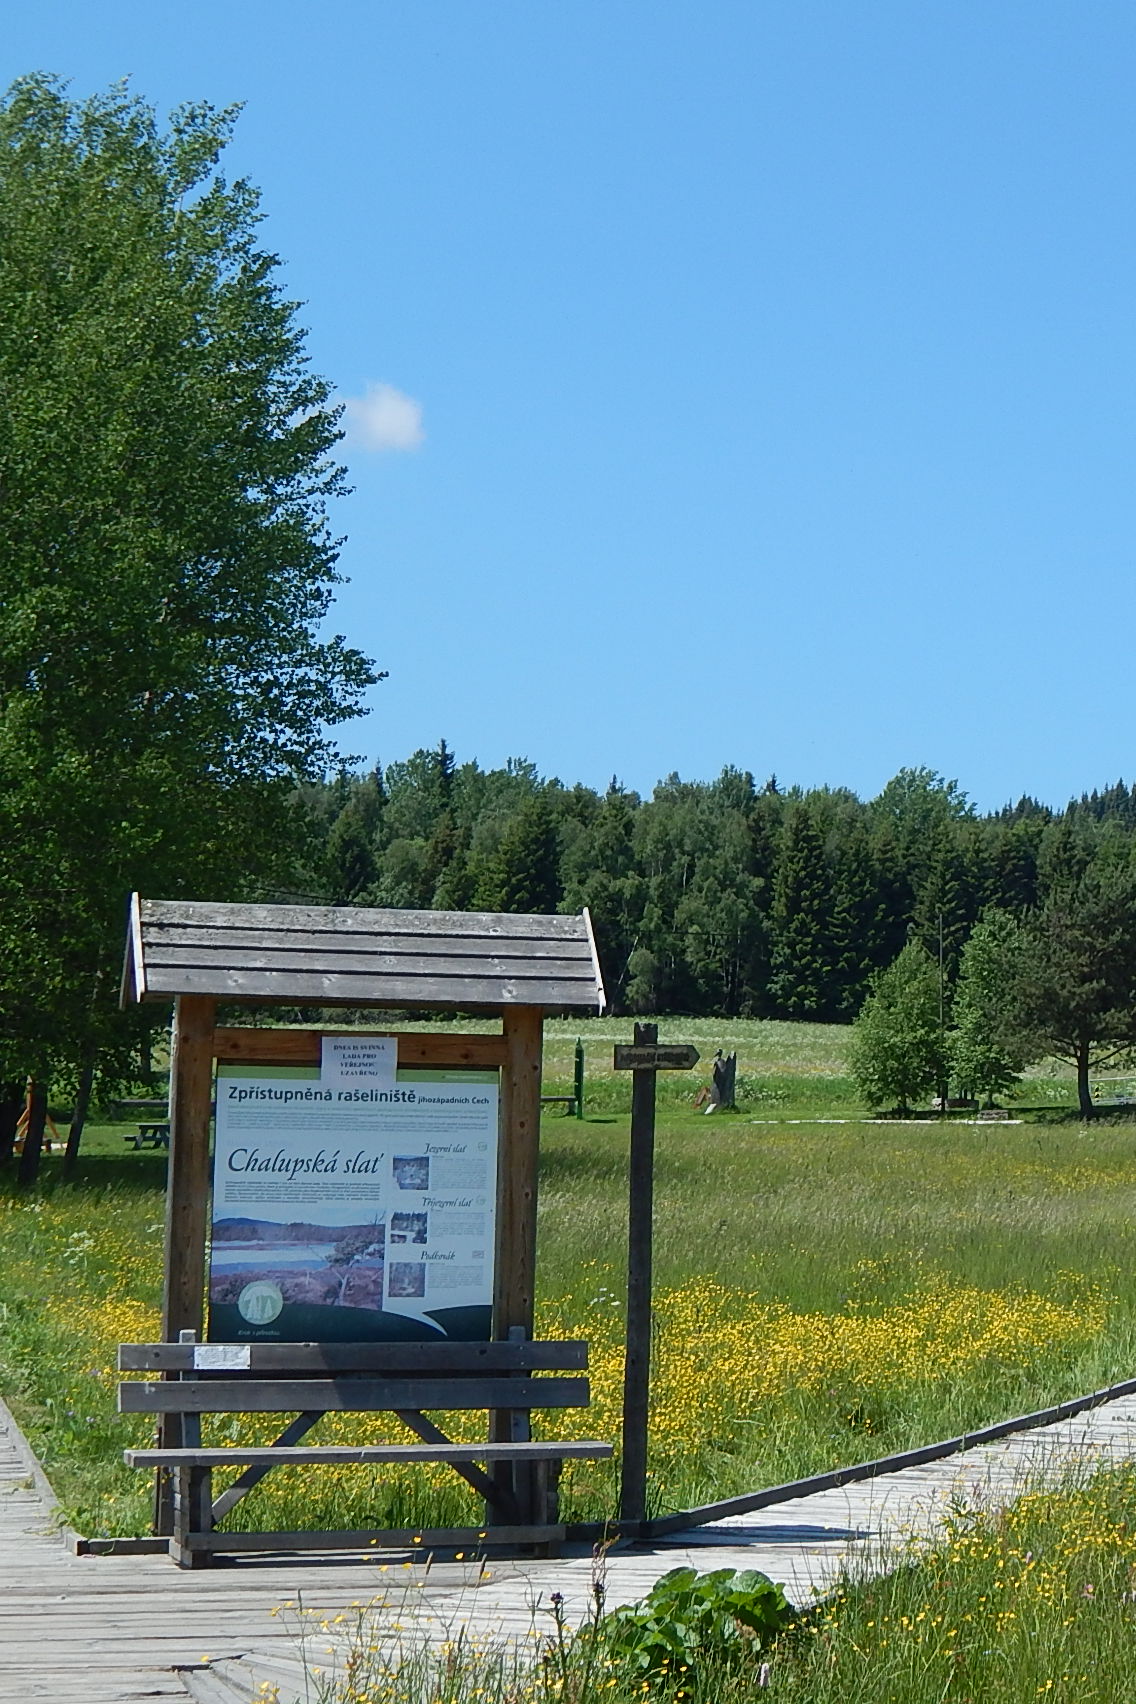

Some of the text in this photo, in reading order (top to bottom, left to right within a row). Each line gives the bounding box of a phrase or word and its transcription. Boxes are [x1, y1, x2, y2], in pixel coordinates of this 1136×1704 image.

[228, 1086, 333, 1103] Zpřístupněná
[337, 1089, 416, 1103] rašeliniště
[228, 1148, 385, 1181] Chalupská slať
